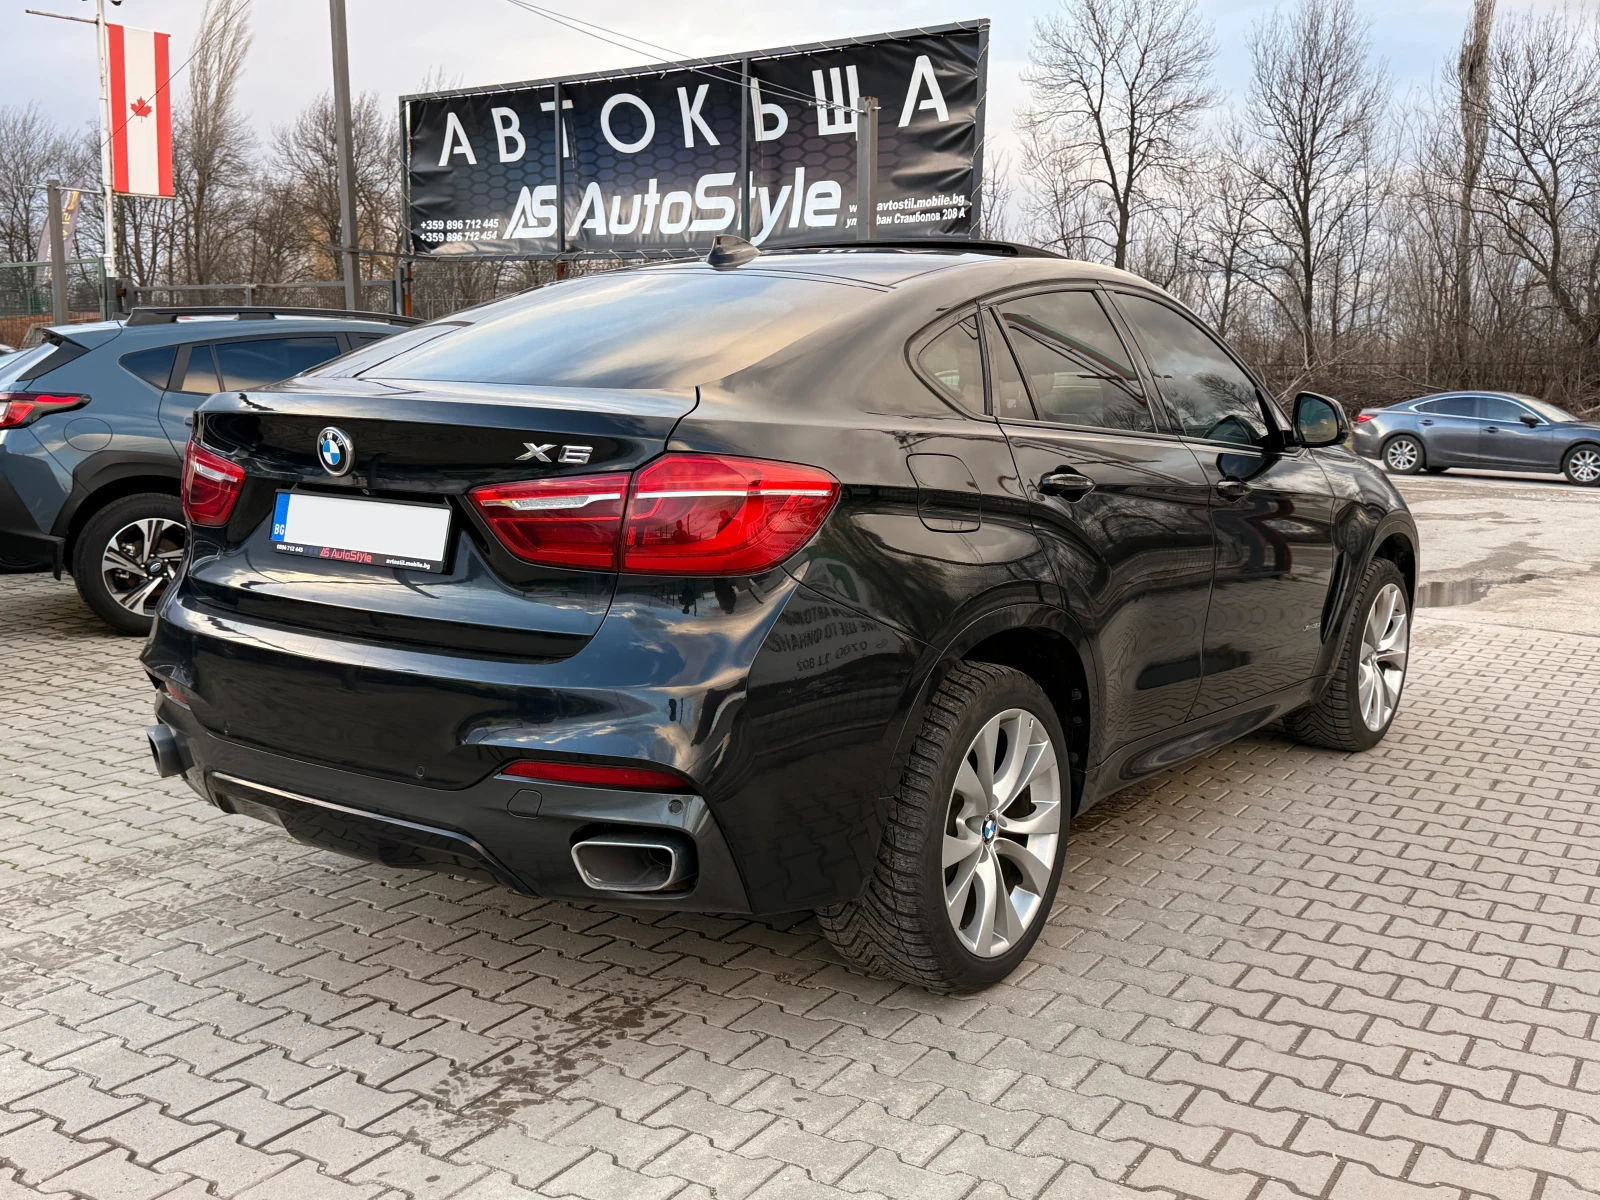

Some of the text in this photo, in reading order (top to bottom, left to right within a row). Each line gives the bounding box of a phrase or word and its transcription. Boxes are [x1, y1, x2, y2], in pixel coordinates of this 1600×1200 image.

[894, 211, 941, 224] Стамболов
[942, 208, 957, 220] 208
[420, 218, 499, 230] +359 896 712 445
[420, 230, 498, 242] +359 896 712 454
[515, 442, 594, 465] X6
[273, 523, 285, 536] BG
[331, 548, 372, 563] AutoStyle
